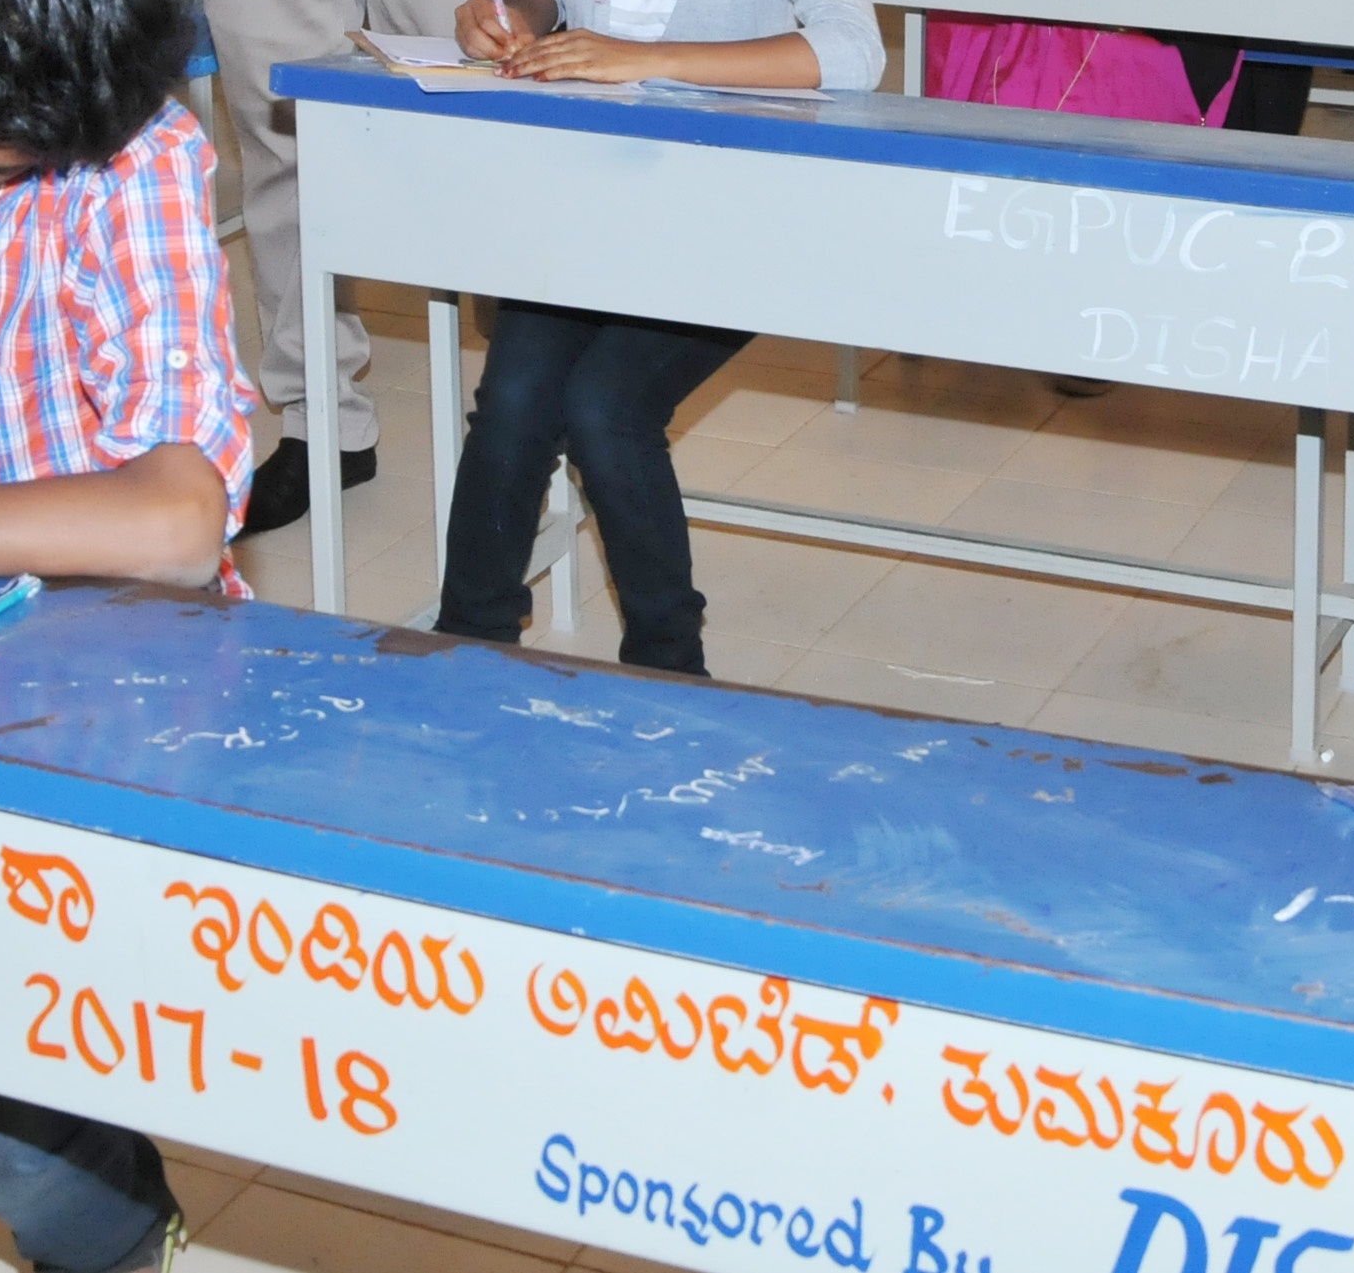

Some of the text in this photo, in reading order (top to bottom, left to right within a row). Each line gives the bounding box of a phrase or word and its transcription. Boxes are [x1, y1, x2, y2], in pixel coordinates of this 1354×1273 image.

[26, 973, 398, 1136] 2017-18
[942, 1047, 1346, 1190] ತುಮಕೂರು
[535, 1132, 877, 1273] Sponsored
